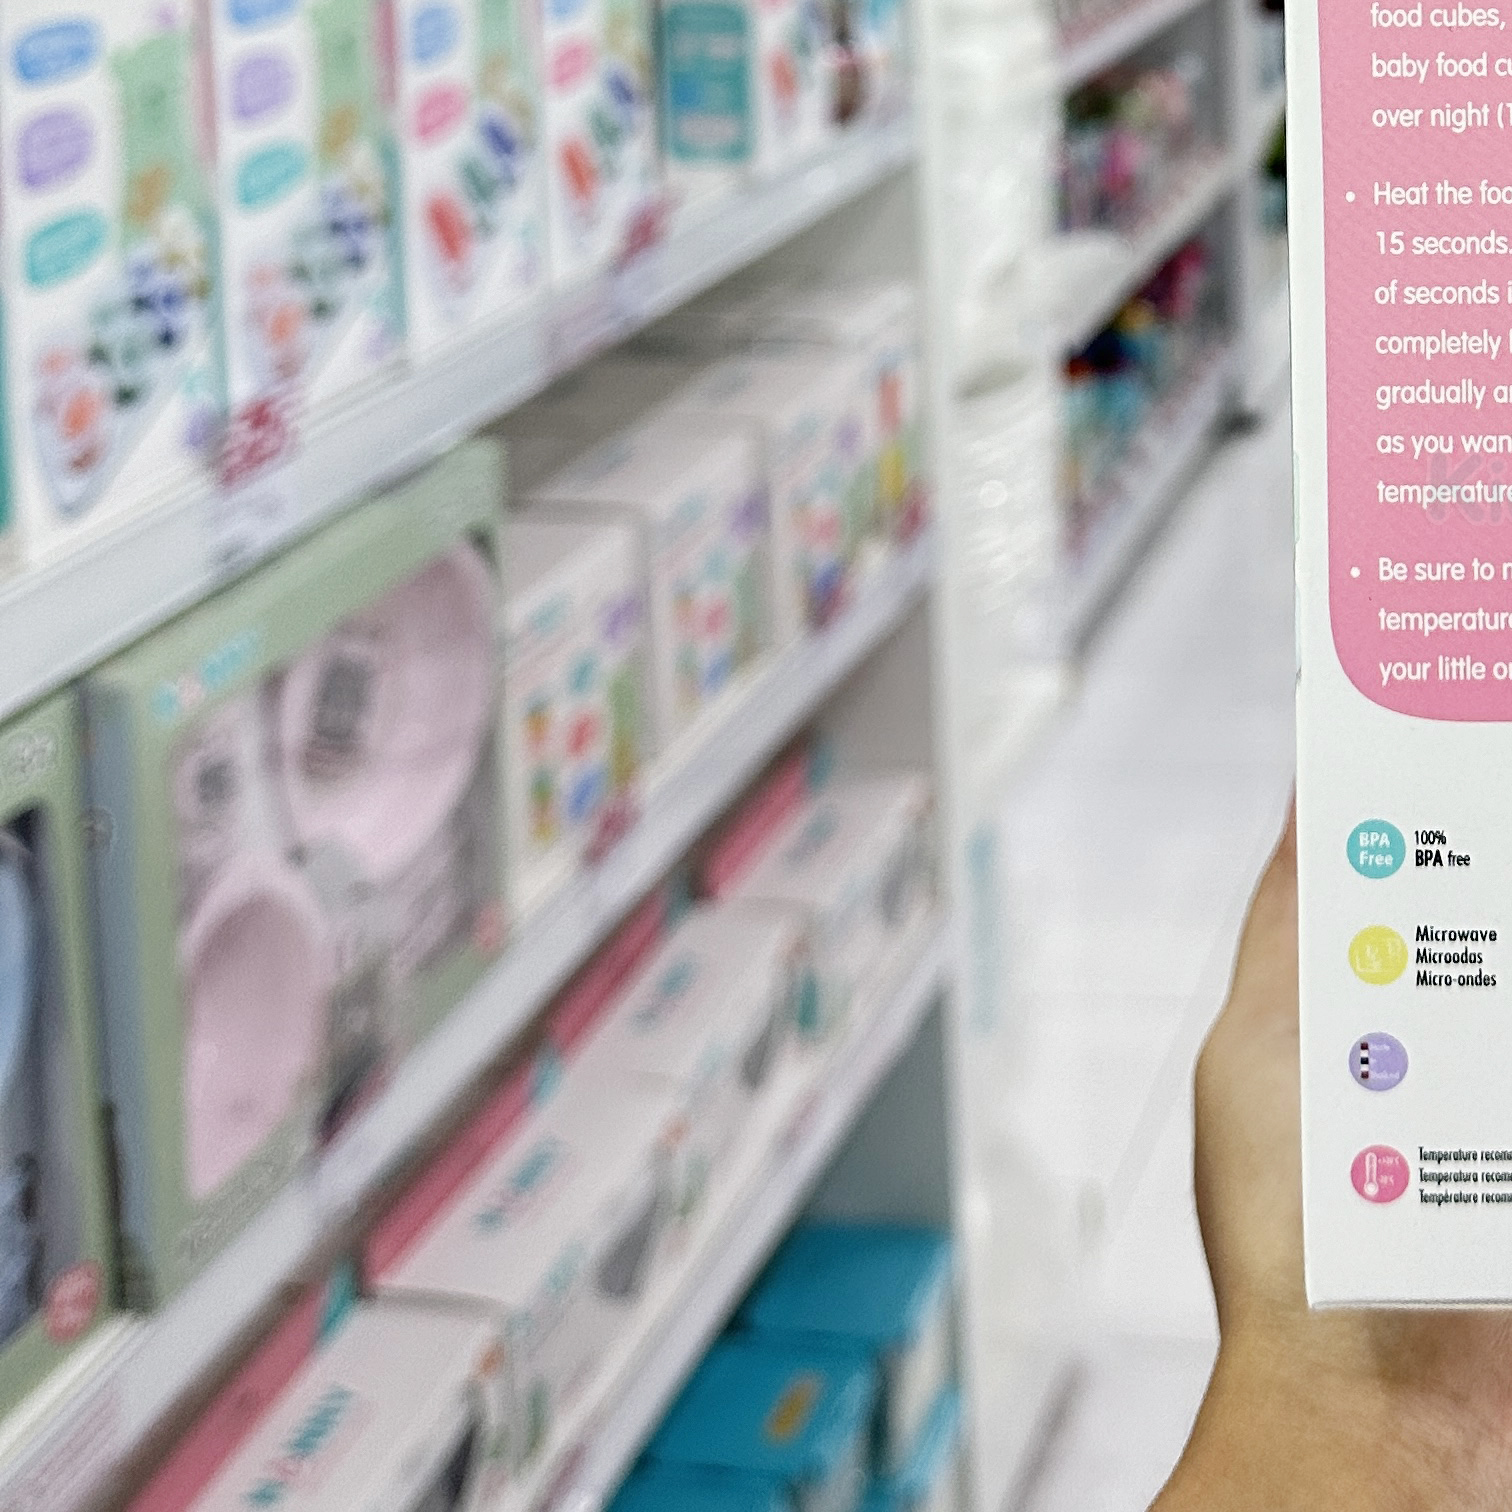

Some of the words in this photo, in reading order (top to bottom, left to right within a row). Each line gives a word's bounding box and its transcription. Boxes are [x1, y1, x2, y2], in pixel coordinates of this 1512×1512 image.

[1372, 52, 1429, 83] baby
[1436, 52, 1487, 77] food
[1372, 109, 1423, 127] over
[1431, 101, 1489, 133] night
[1374, 182, 1429, 205] Heat
[1435, 180, 1473, 204] the
[1376, 231, 1404, 254] 15
[1412, 230, 1512, 254] seconds.
[1376, 329, 1501, 360] completely
[1376, 379, 1486, 410] gradually
[1377, 435, 1404, 453] as
[1411, 435, 1453, 459] you
[1379, 662, 1431, 686] your
[1439, 655, 1486, 680] little
[1359, 831, 1391, 848] BPA
[1415, 830, 1446, 845] 100%
[1416, 849, 1443, 867] BPA
[1448, 850, 1470, 866] free
[1416, 926, 1497, 941] Microwave
[1417, 969, 1496, 986] Micro-ondes
